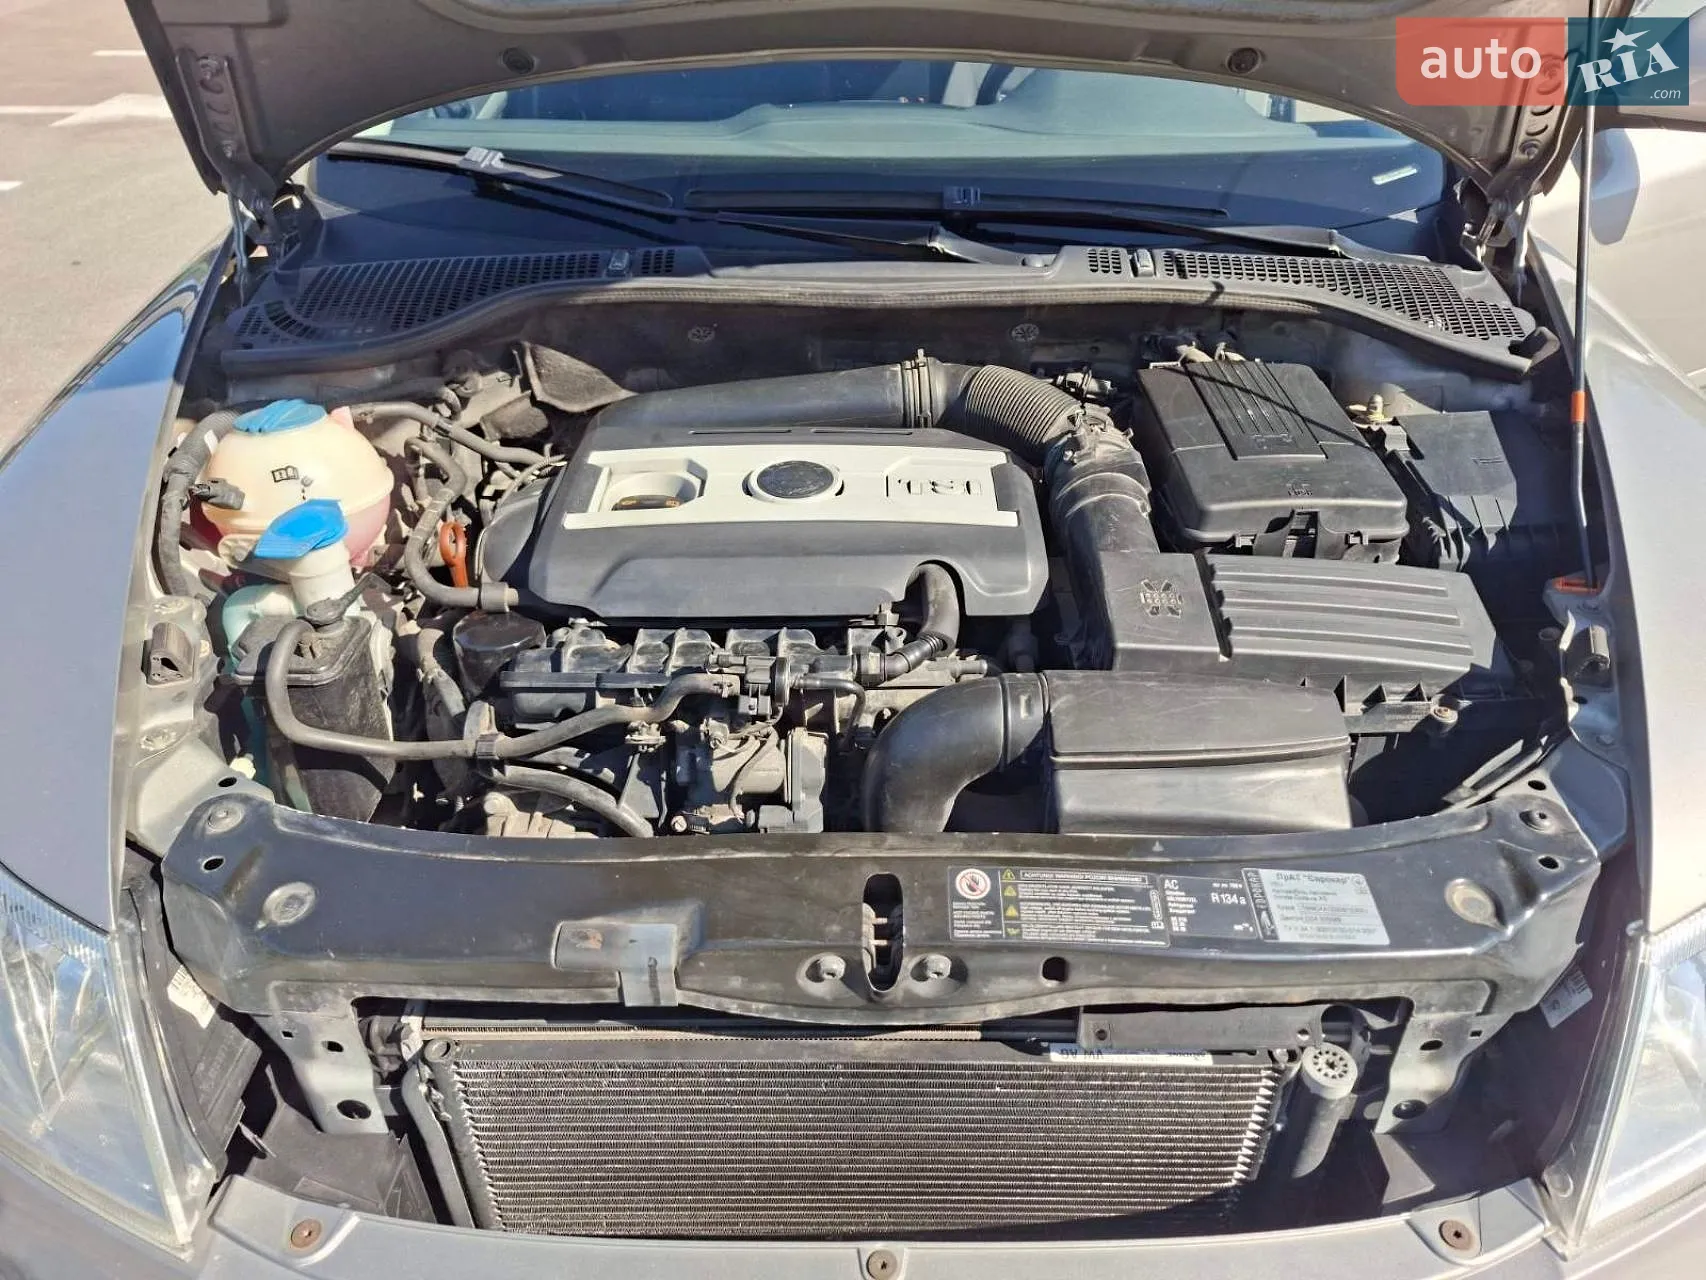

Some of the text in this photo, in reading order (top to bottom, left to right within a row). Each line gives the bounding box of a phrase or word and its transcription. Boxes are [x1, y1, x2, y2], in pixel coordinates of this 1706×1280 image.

[897, 479, 982, 495] TSI
[1164, 879, 1179, 890] AC
[1211, 892, 1220, 904] R
[1220, 893, 1238, 905] 134
